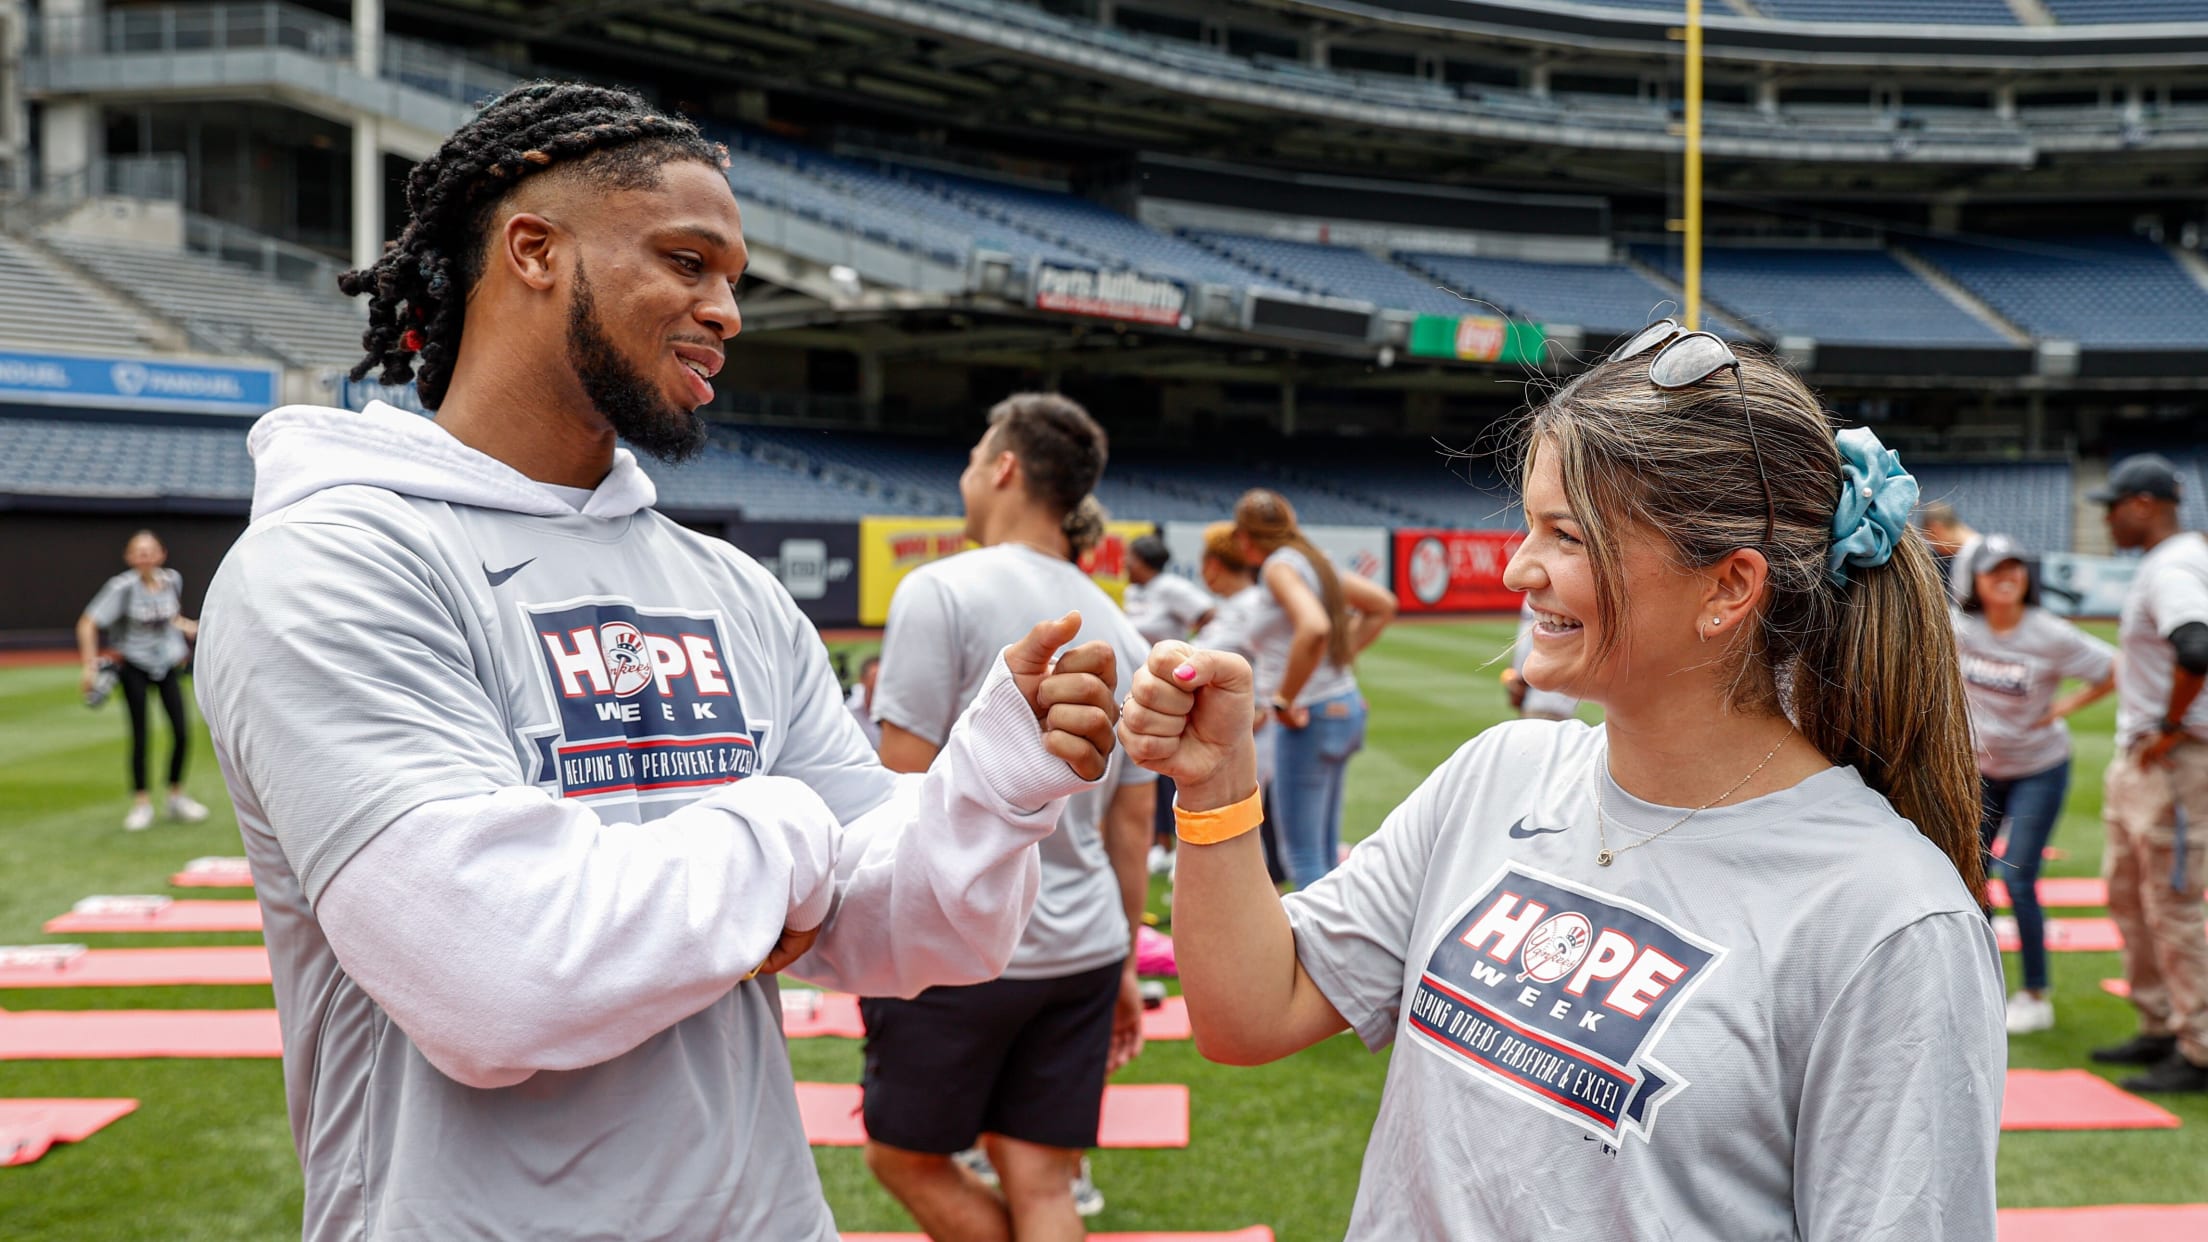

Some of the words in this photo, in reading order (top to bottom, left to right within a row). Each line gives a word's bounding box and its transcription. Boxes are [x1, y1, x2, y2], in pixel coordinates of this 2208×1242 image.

[541, 621, 732, 698] HOPE
[595, 702, 718, 722] WEEK
[564, 754, 614, 786] HELPING
[641, 749, 715, 779] PERSEVERE
[718, 747, 728, 773] &
[1459, 890, 1690, 1021] HOPE
[1470, 960, 1606, 1033] WEEK
[1412, 987, 1453, 1028] HELPING
[1448, 1010, 1501, 1052] OTHERS
[1494, 1035, 1565, 1084] PERSEVERE
[1557, 1063, 1576, 1090] &
[1571, 1068, 1620, 1114] EXCEL
